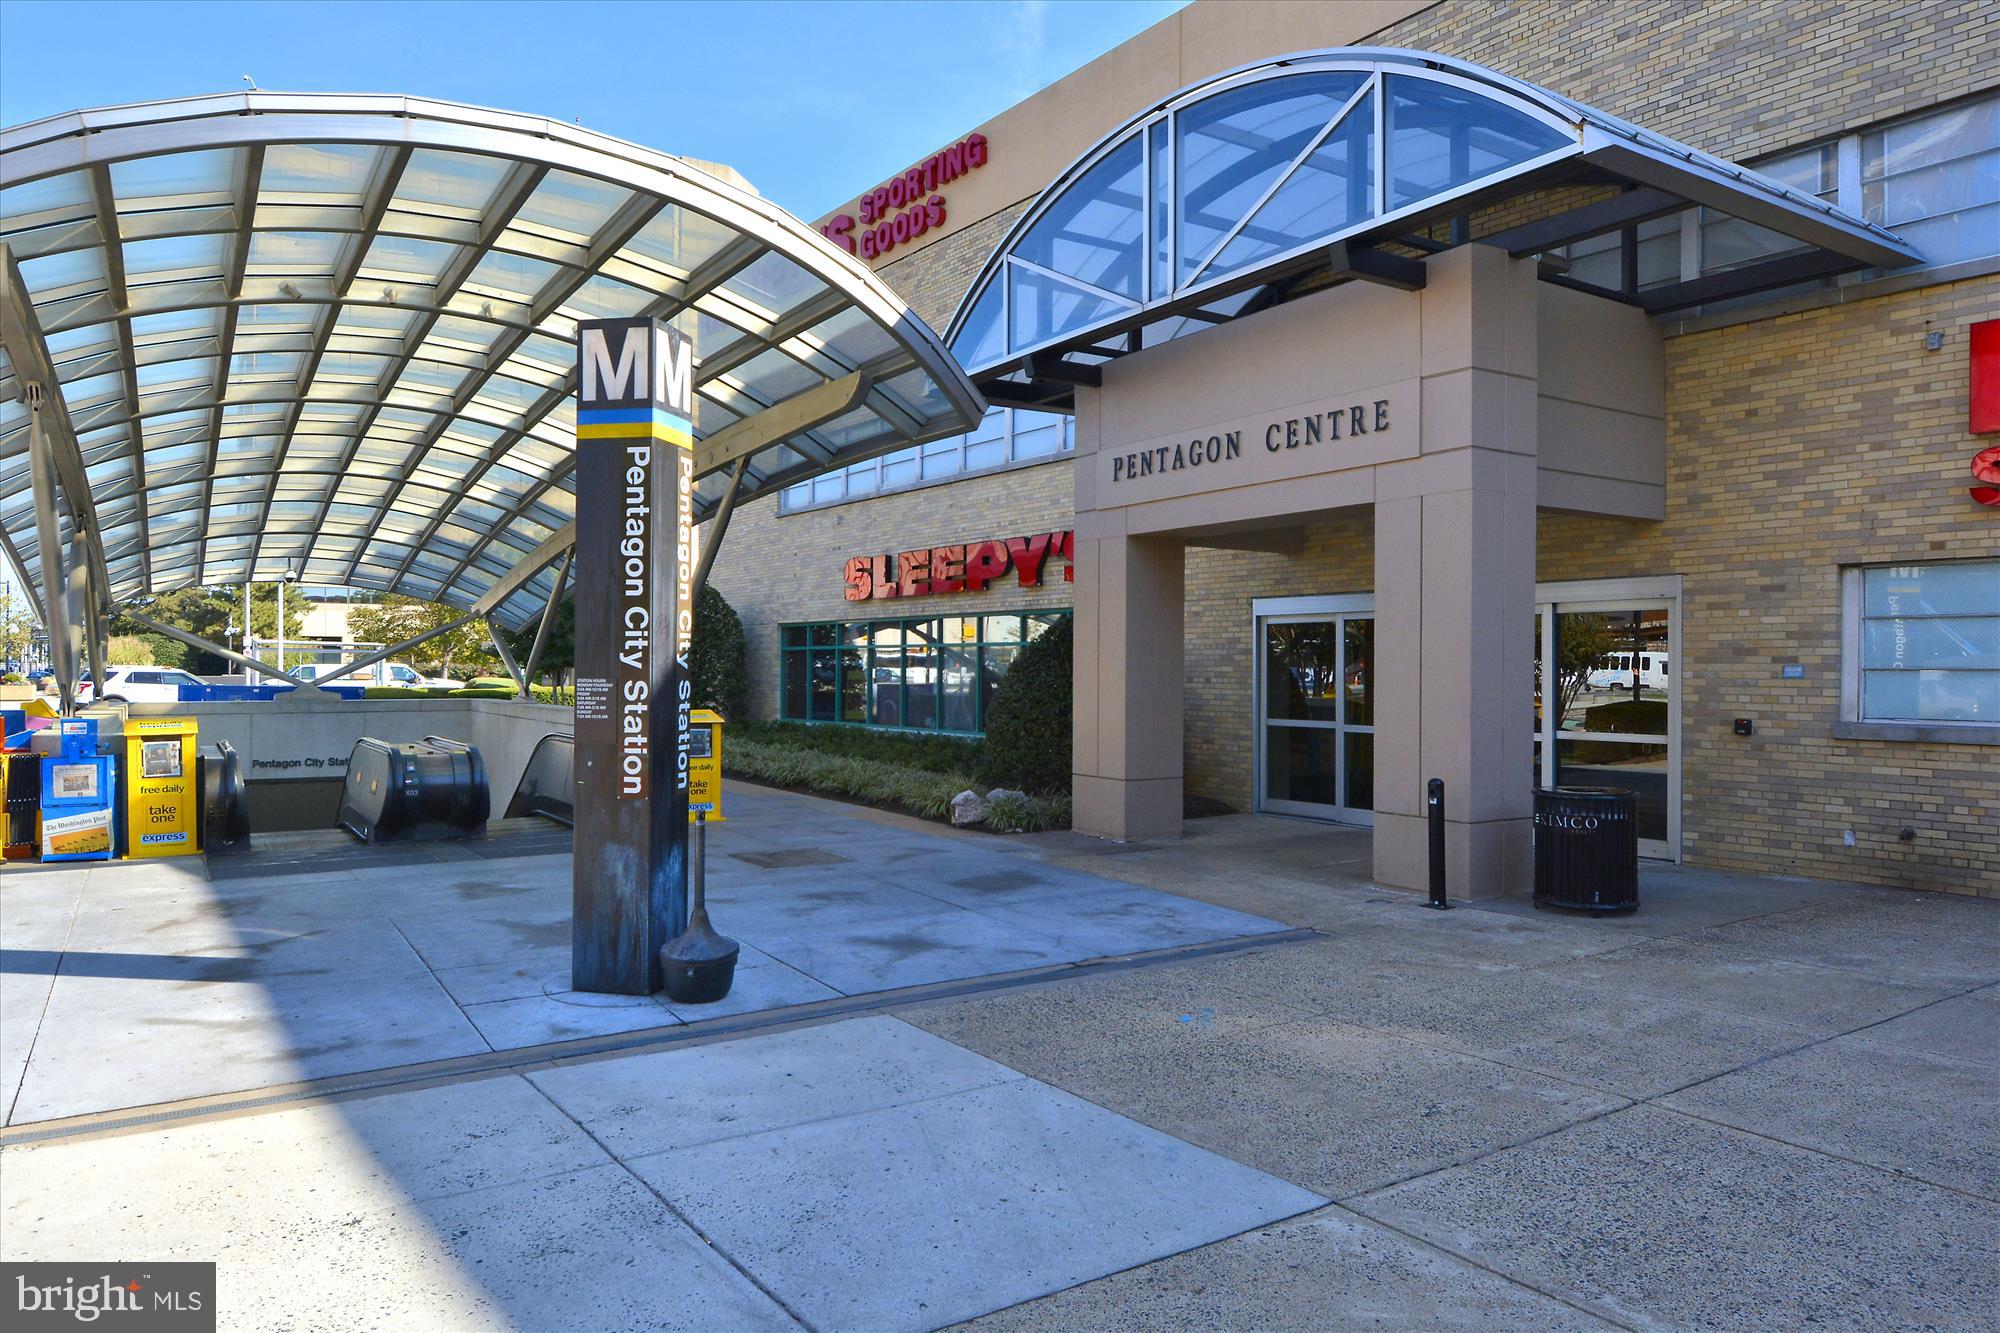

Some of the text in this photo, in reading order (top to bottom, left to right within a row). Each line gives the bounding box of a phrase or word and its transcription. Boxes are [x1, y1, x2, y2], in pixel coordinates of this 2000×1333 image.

[859, 132, 988, 225] SPORTING
[861, 194, 946, 260] GOODS
[582, 327, 648, 402] M
[655, 327, 691, 415] M
[1113, 400, 1389, 482] PENTAGON CENTRE
[843, 530, 1073, 600] SLEEPY'
[619, 446, 650, 794] Pentagon City Station
[677, 456, 692, 789] Pentagon City Station
[252, 757, 350, 769] Pentagon City Stat
[699, 763, 714, 771] daily
[140, 785, 184, 794] free daily
[690, 780, 708, 788] take
[149, 804, 176, 815] take
[688, 803, 712, 811] xpress
[57, 817, 93, 830] Washington
[151, 814, 175, 823] one
[142, 832, 185, 843] express
